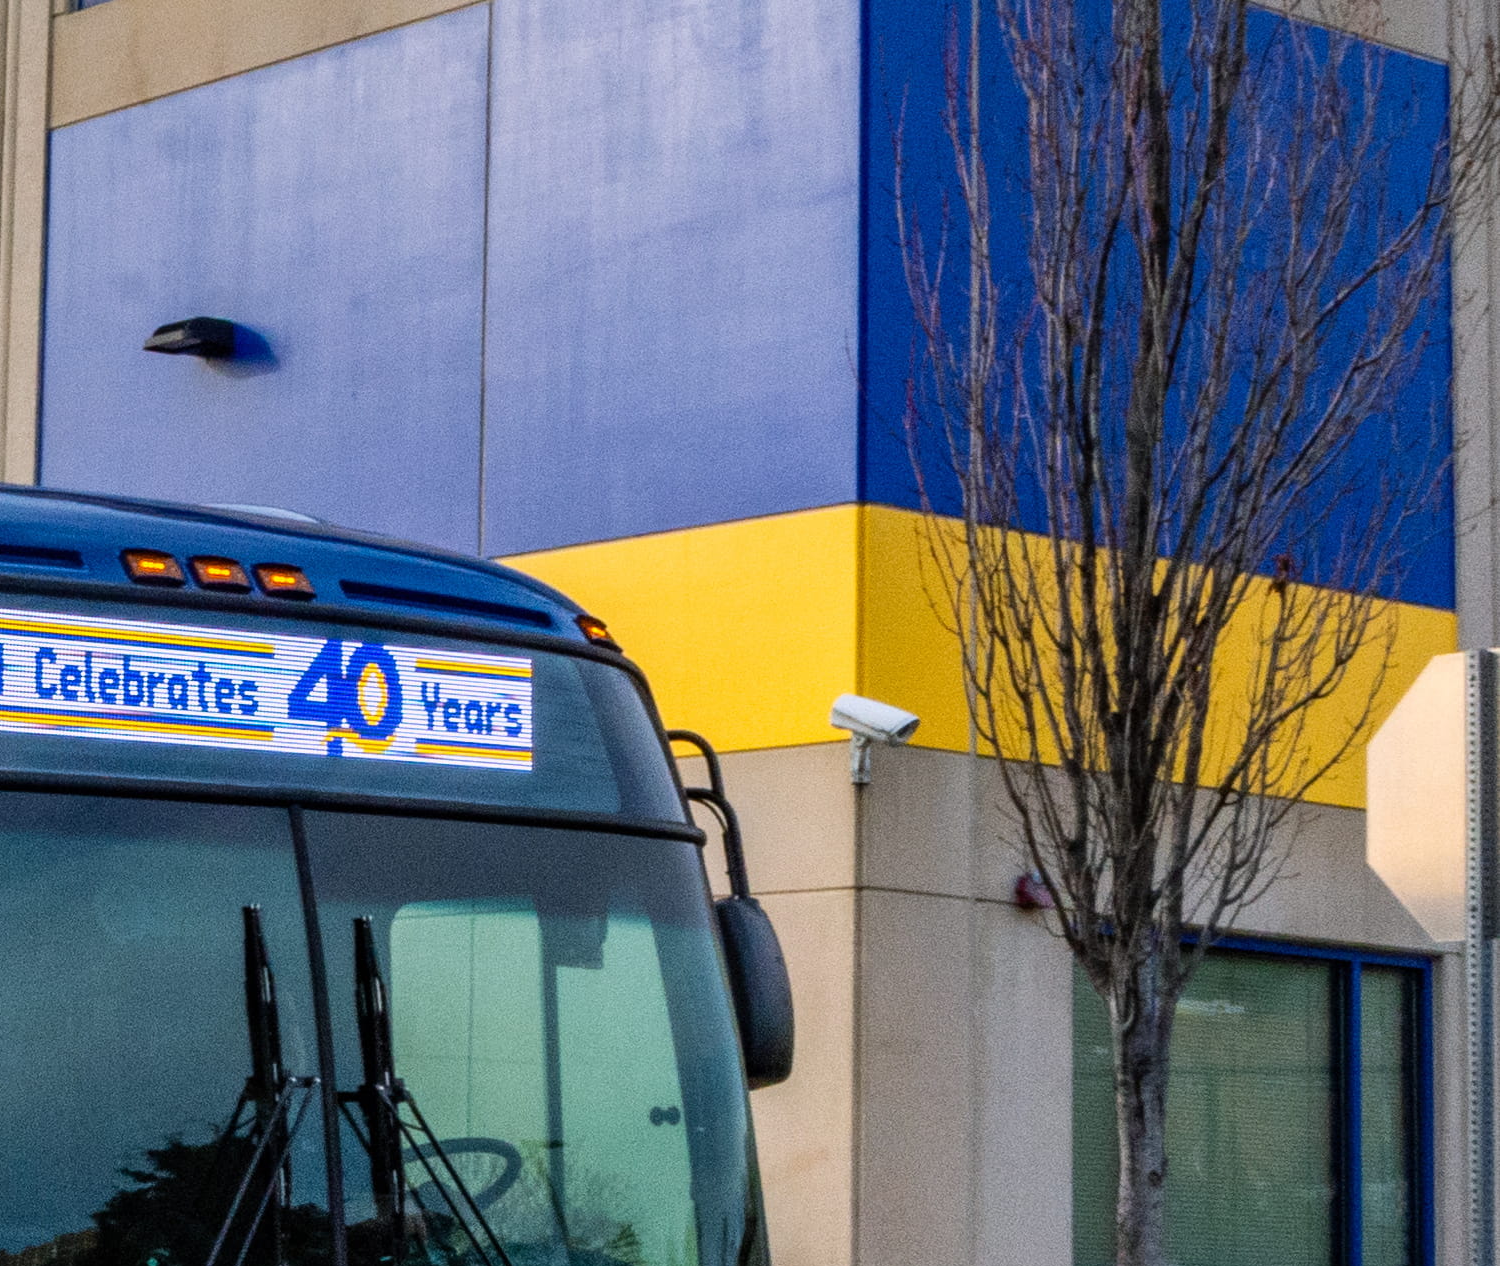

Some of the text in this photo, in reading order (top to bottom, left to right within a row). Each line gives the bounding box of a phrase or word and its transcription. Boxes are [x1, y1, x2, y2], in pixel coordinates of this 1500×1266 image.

[35, 647, 259, 715] Celebrates
[287, 638, 403, 757] 40
[421, 681, 523, 738] Years
